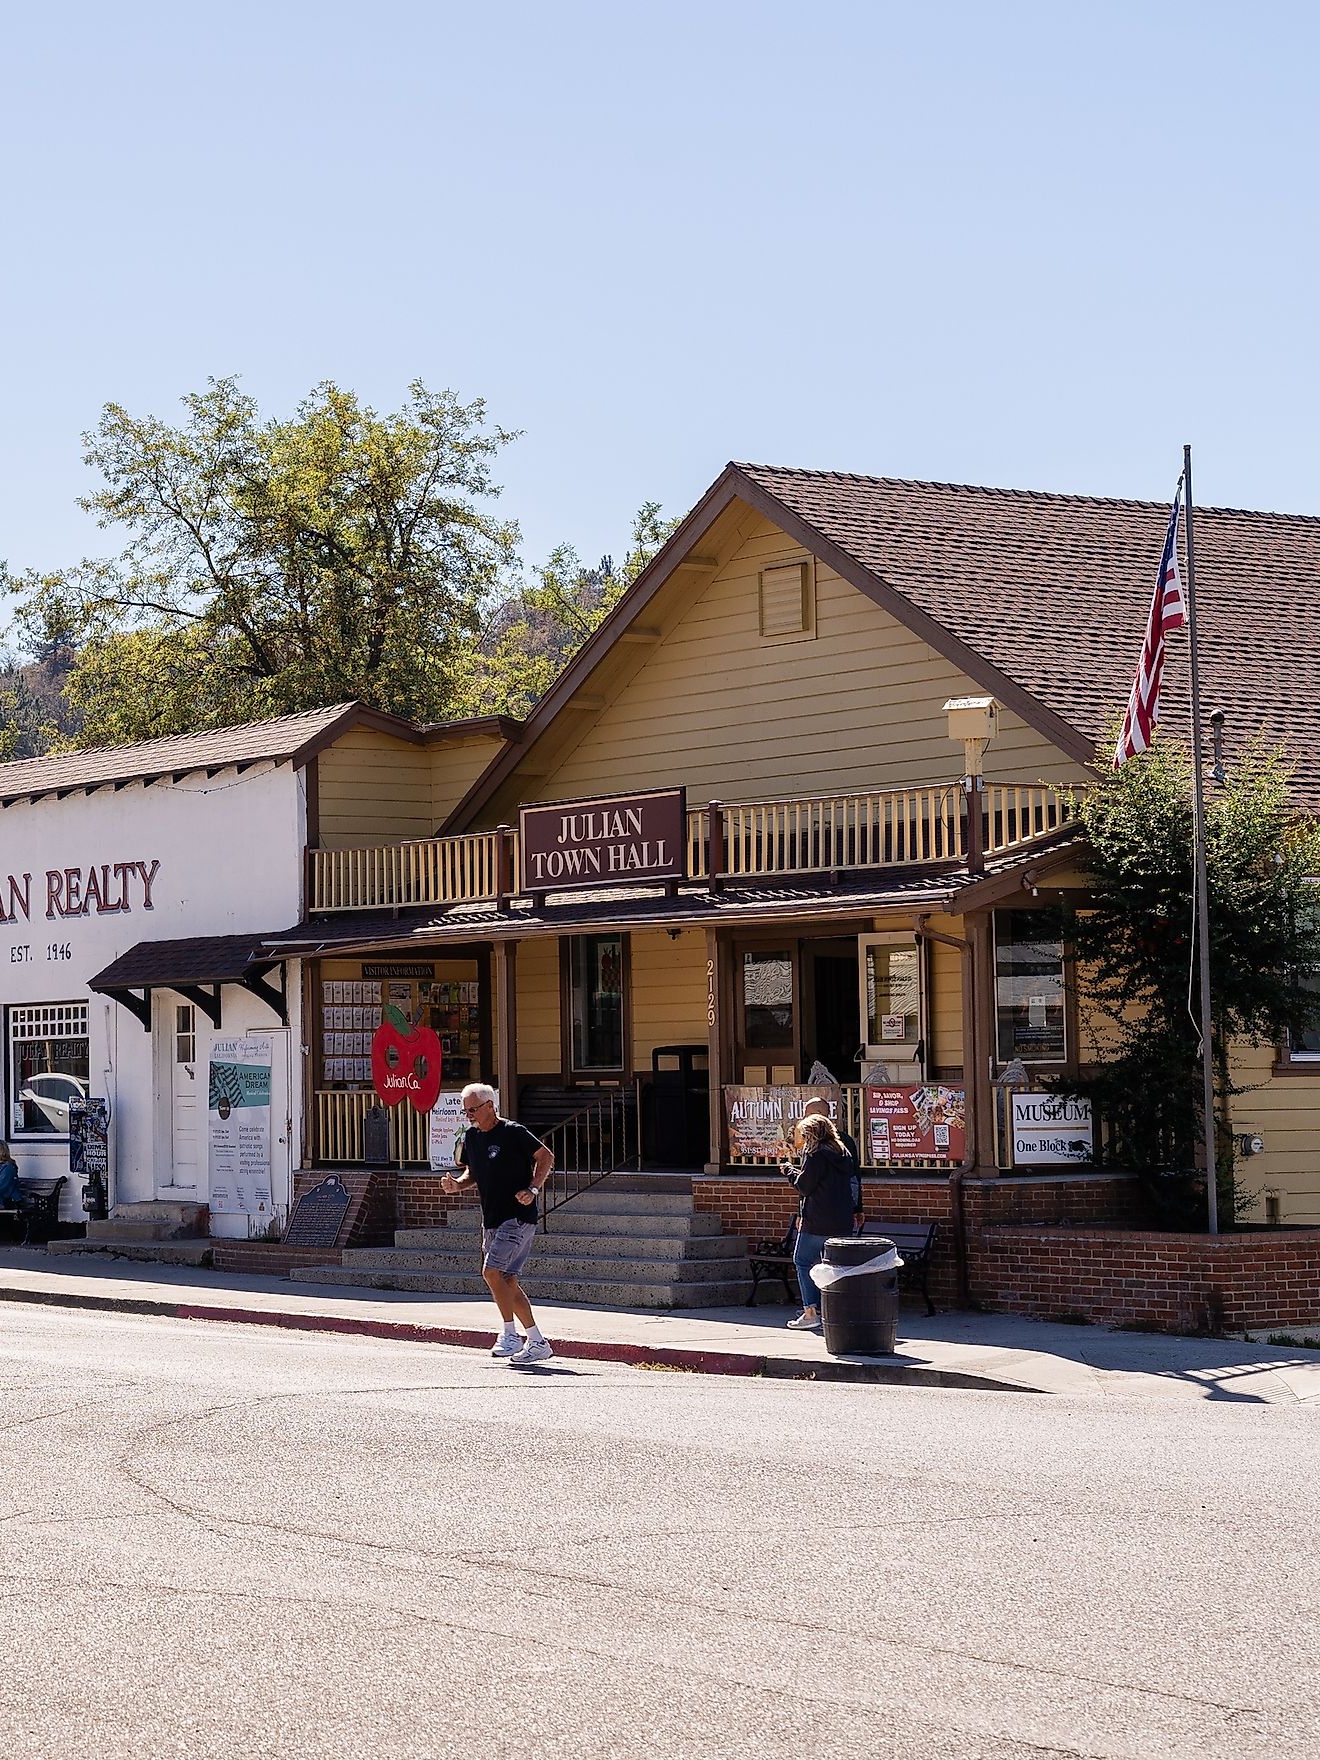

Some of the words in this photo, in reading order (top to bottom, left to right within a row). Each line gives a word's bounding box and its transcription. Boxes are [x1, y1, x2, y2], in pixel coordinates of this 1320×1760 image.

[557, 807, 644, 844] JULIAN
[531, 847, 601, 879] TOWN
[607, 839, 674, 872] HALL
[45, 859, 161, 921] REALTY
[10, 945, 33, 963] EST.
[46, 942, 72, 961] 1946
[364, 966, 389, 976] VISITOR
[389, 965, 433, 976] INFORMATION
[706, 959, 715, 1027] 2129
[214, 1043, 238, 1052] JULIAN
[239, 1072, 271, 1081] AMERICAN
[245, 1081, 268, 1089] DREAM
[383, 1074, 408, 1089] Julian
[407, 1072, 421, 1090] Ca
[730, 1098, 783, 1123] AUTUMN
[1015, 1104, 1089, 1122] MUSEUM
[1016, 1139, 1038, 1153] One
[1038, 1139, 1067, 1152] Block
